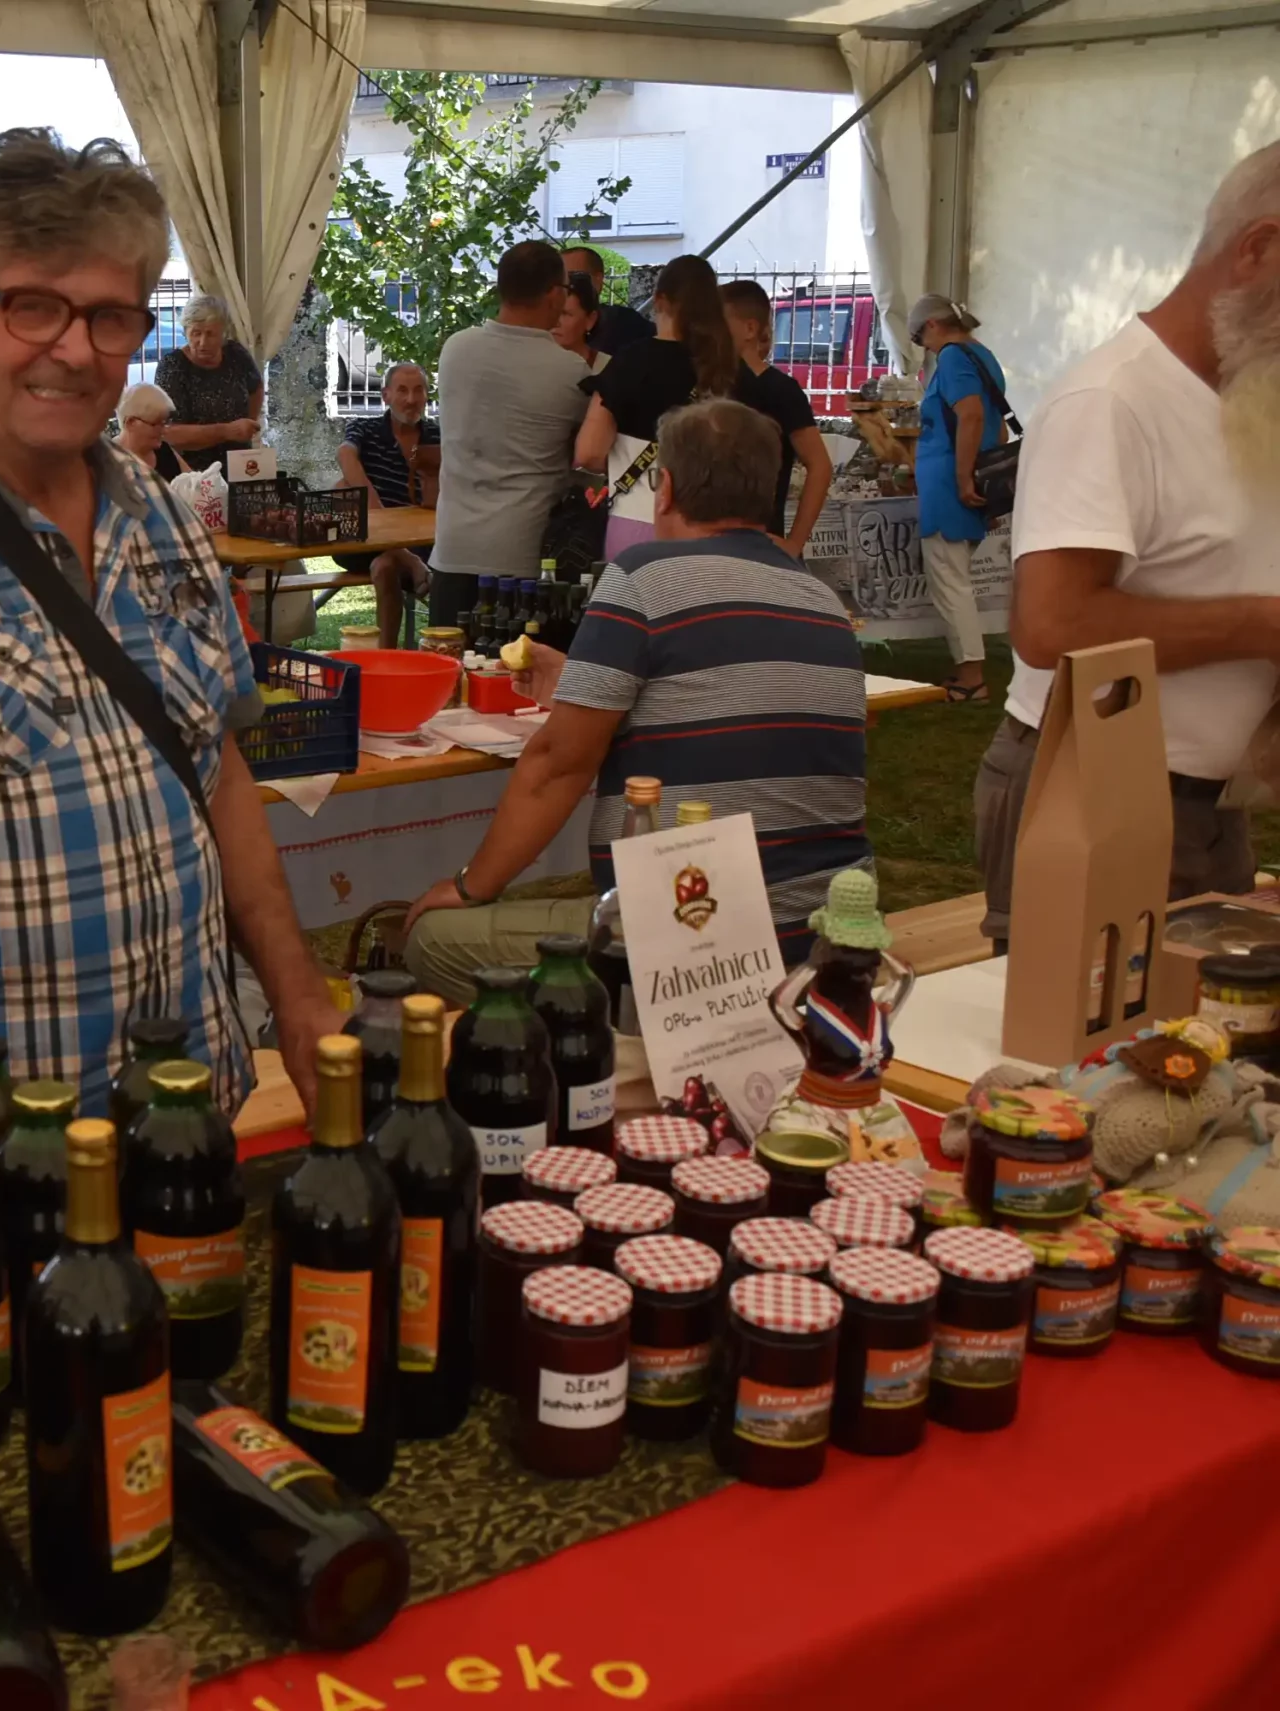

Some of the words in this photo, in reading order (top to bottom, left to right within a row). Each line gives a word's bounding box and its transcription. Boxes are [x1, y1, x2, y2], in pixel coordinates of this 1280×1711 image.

[812, 544, 849, 557] KAMEN
[645, 948, 772, 1005] Zahvalnicu
[486, 1133, 525, 1146] SOK
[253, 1644, 649, 1711] A-eko
